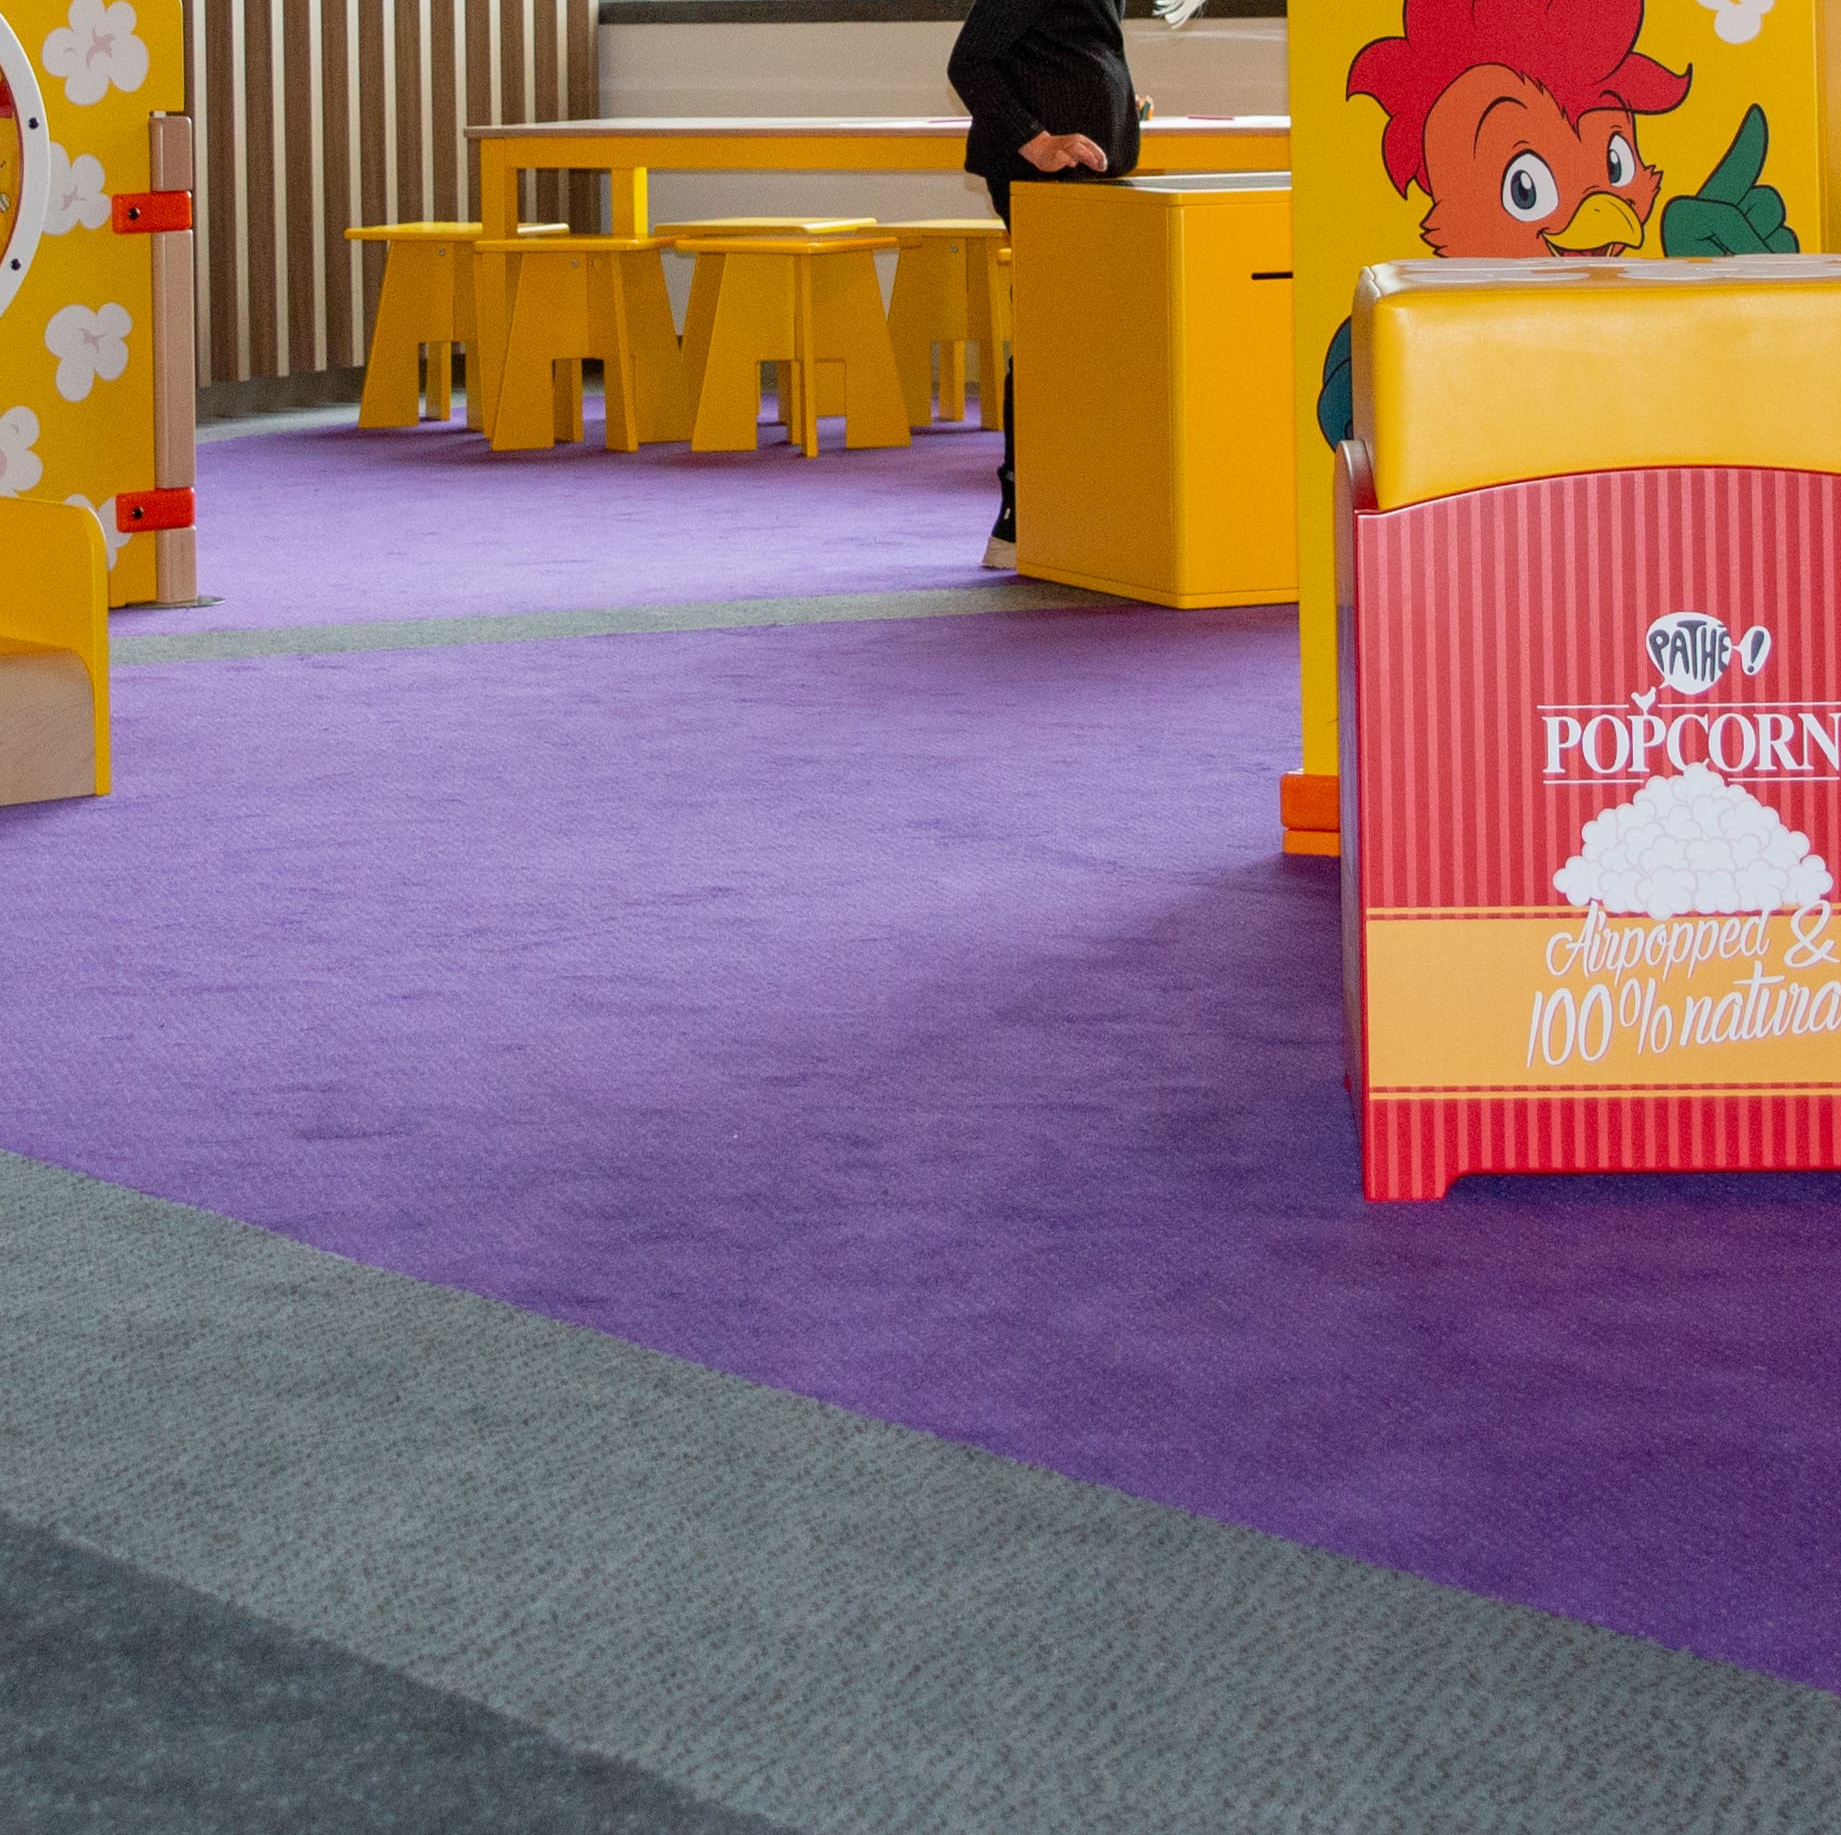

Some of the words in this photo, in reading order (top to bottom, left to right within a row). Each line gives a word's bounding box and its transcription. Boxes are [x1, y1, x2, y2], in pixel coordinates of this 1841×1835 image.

[1545, 899, 1771, 987] Airpopped
[1783, 898, 1841, 969] &
[1525, 976, 1674, 1069] 100%
